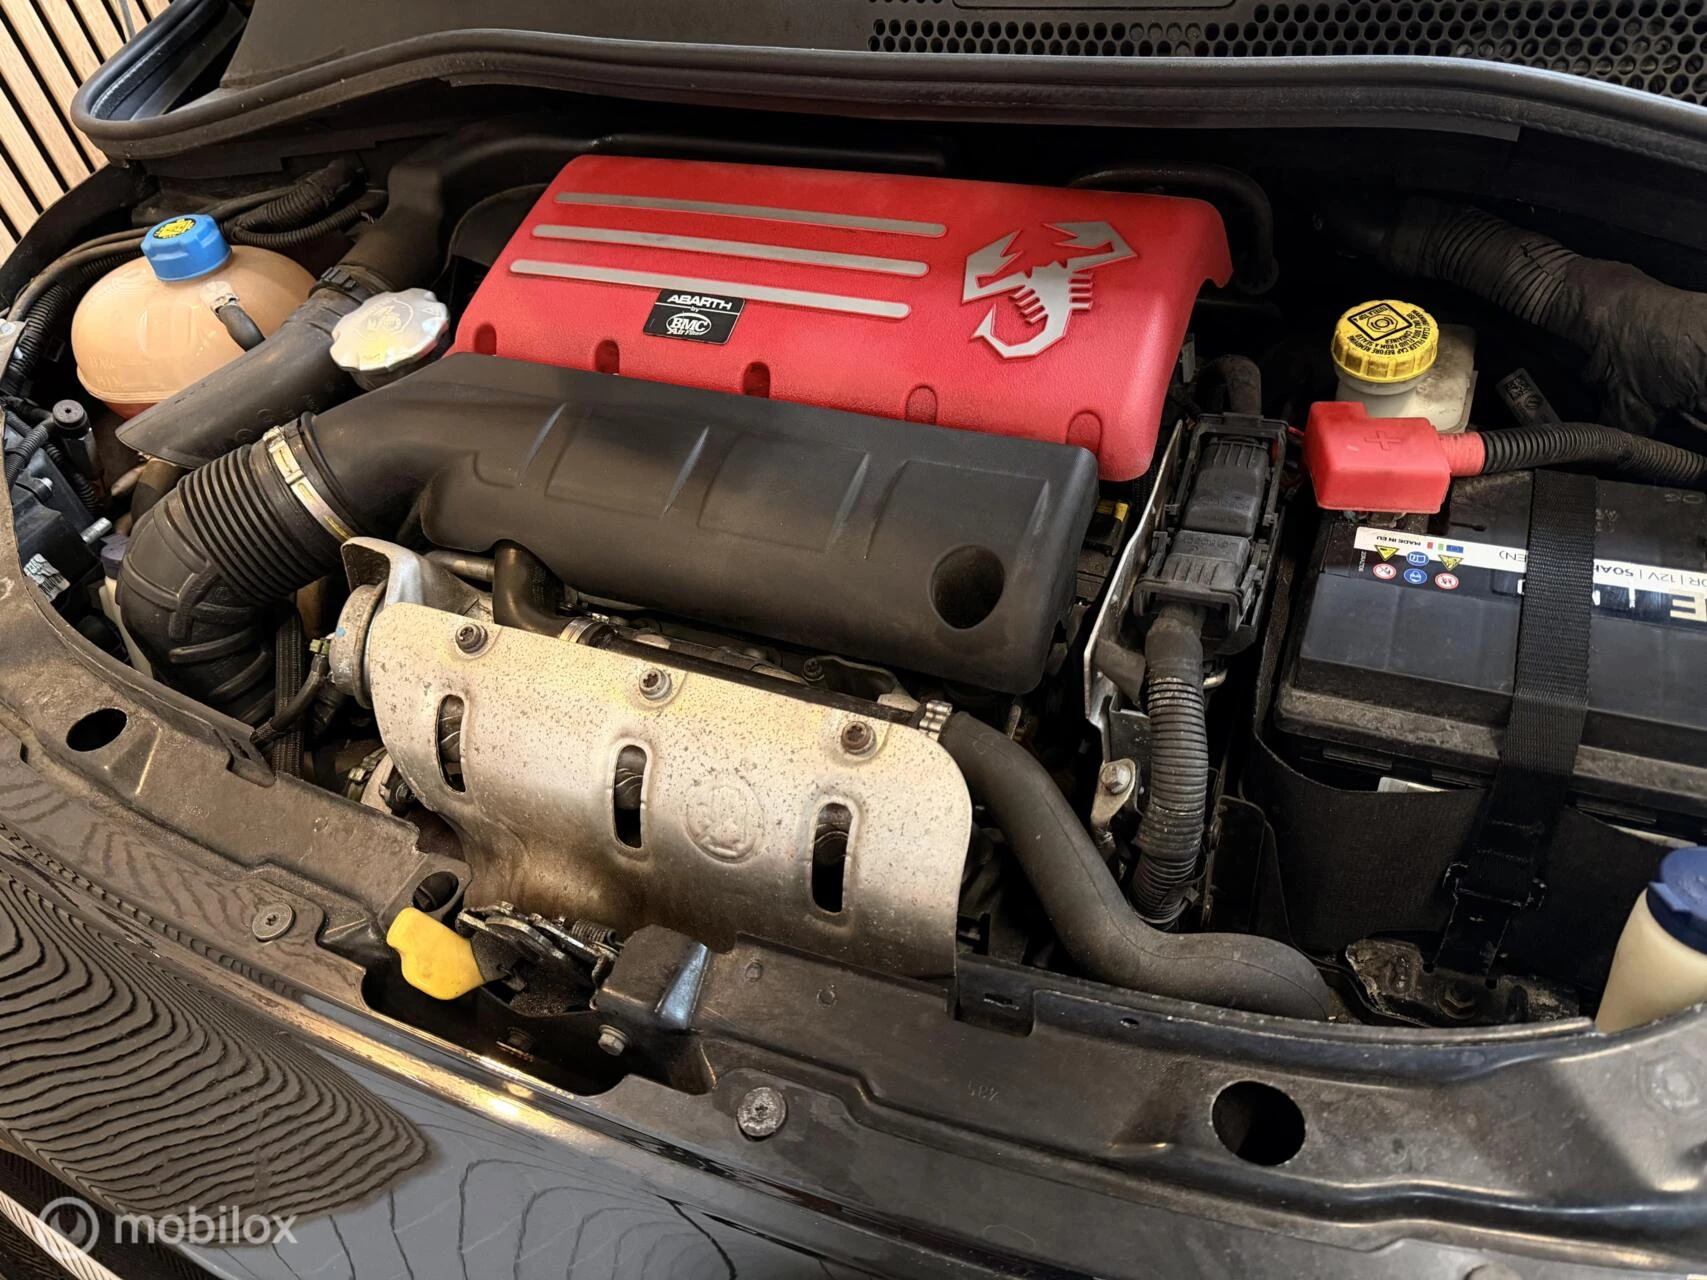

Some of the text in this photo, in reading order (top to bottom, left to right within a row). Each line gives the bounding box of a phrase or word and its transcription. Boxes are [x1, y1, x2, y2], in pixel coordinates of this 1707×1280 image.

[666, 294, 732, 310] ABARTH
[670, 317, 708, 332] BMC
[1371, 347, 1395, 356] BEFORE
[1396, 347, 1409, 355] CAP
[1398, 538, 1421, 546] MADE
[1648, 571, 1675, 583] 12V
